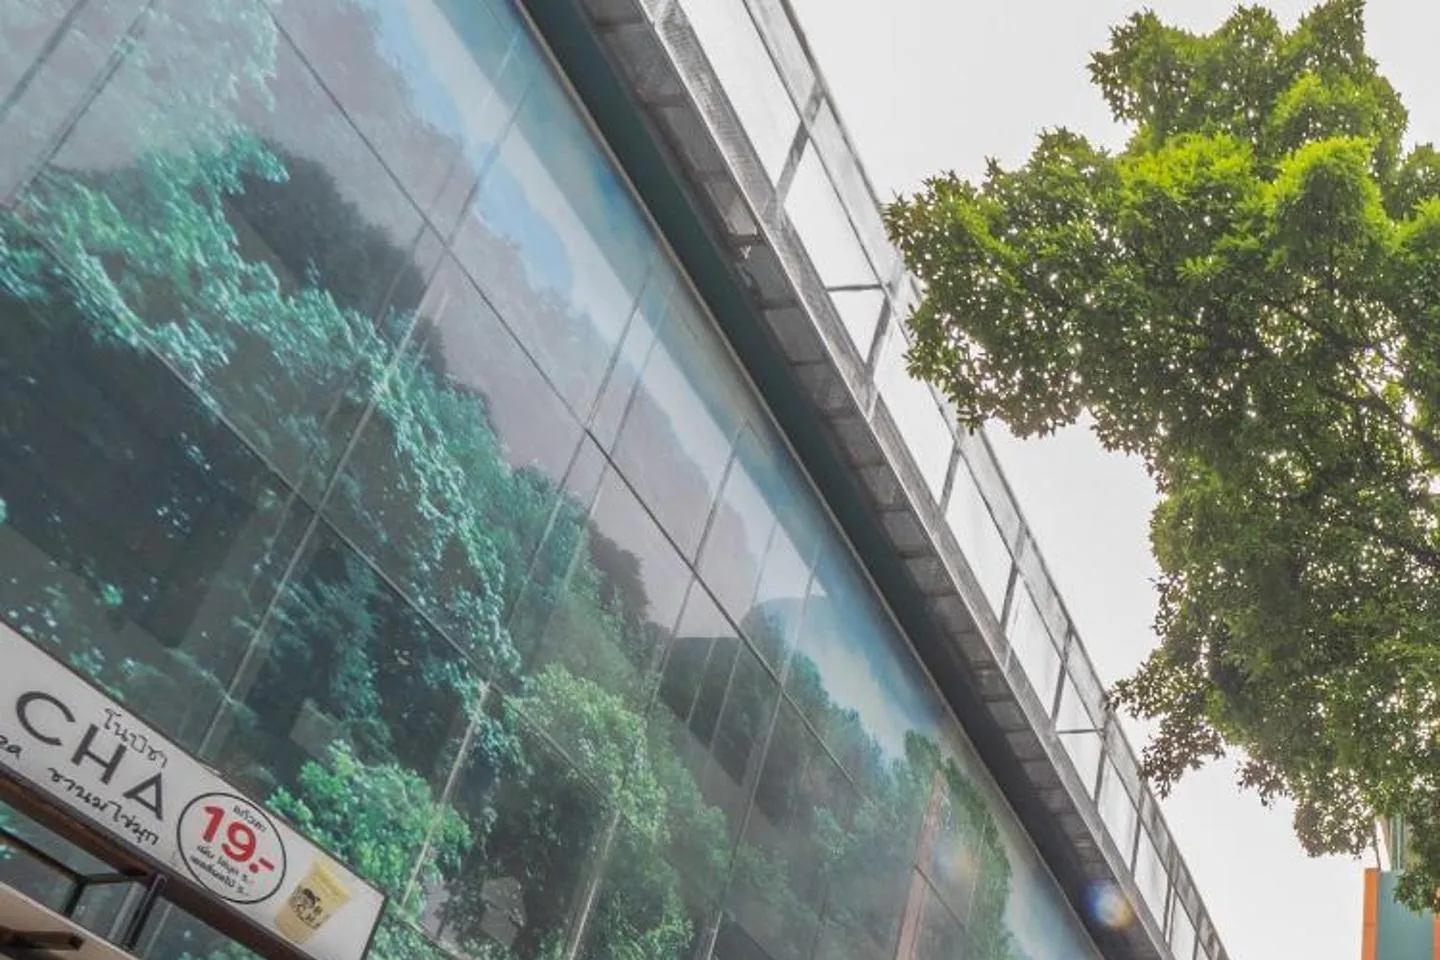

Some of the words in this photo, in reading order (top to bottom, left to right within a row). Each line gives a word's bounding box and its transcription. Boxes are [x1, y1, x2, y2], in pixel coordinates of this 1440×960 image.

[16, 691, 164, 820] CHA
[48, 767, 159, 845] ชานมไข่มุก
[203, 805, 275, 874] 19.-
